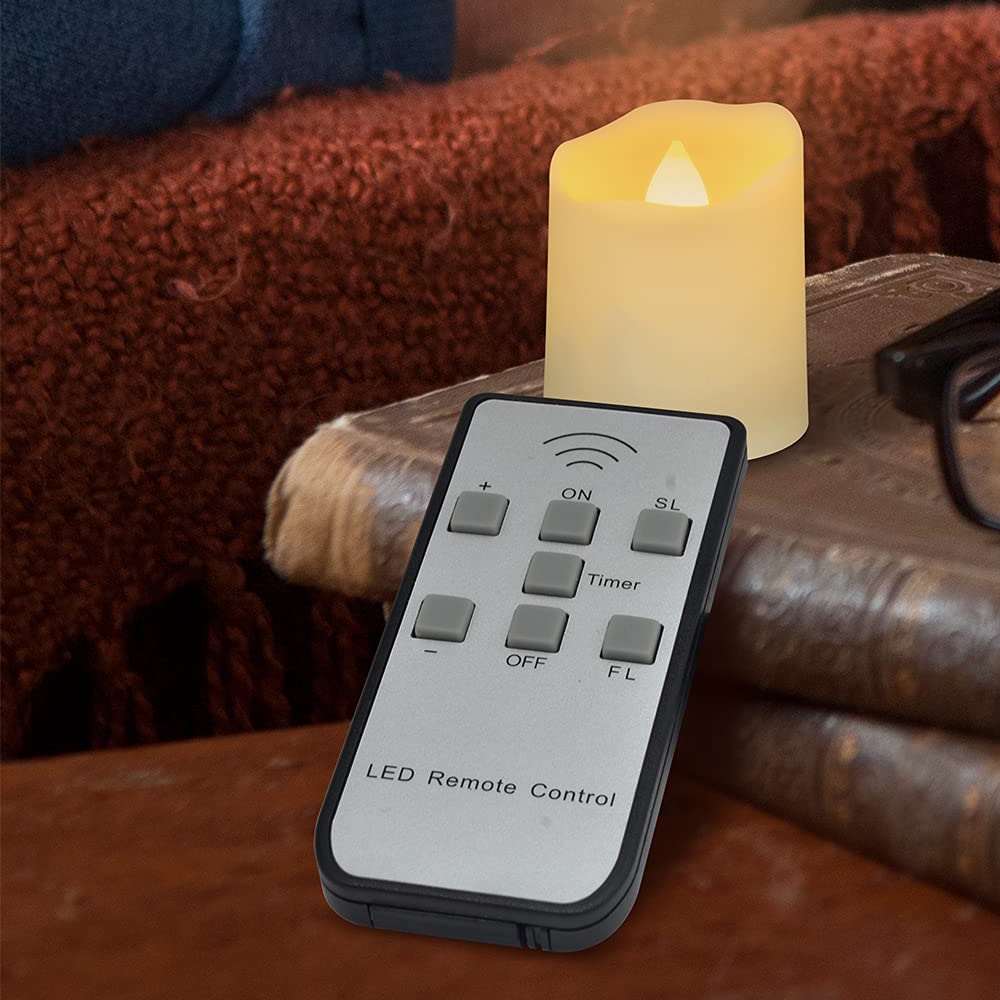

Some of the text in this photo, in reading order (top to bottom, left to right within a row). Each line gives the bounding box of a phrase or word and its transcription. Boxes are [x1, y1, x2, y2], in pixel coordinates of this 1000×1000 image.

[561, 487, 593, 502] ON
[654, 497, 681, 511] SL
[587, 573, 642, 591] Timer
[505, 653, 548, 670] OFF
[366, 763, 616, 807] LED Remote Control
